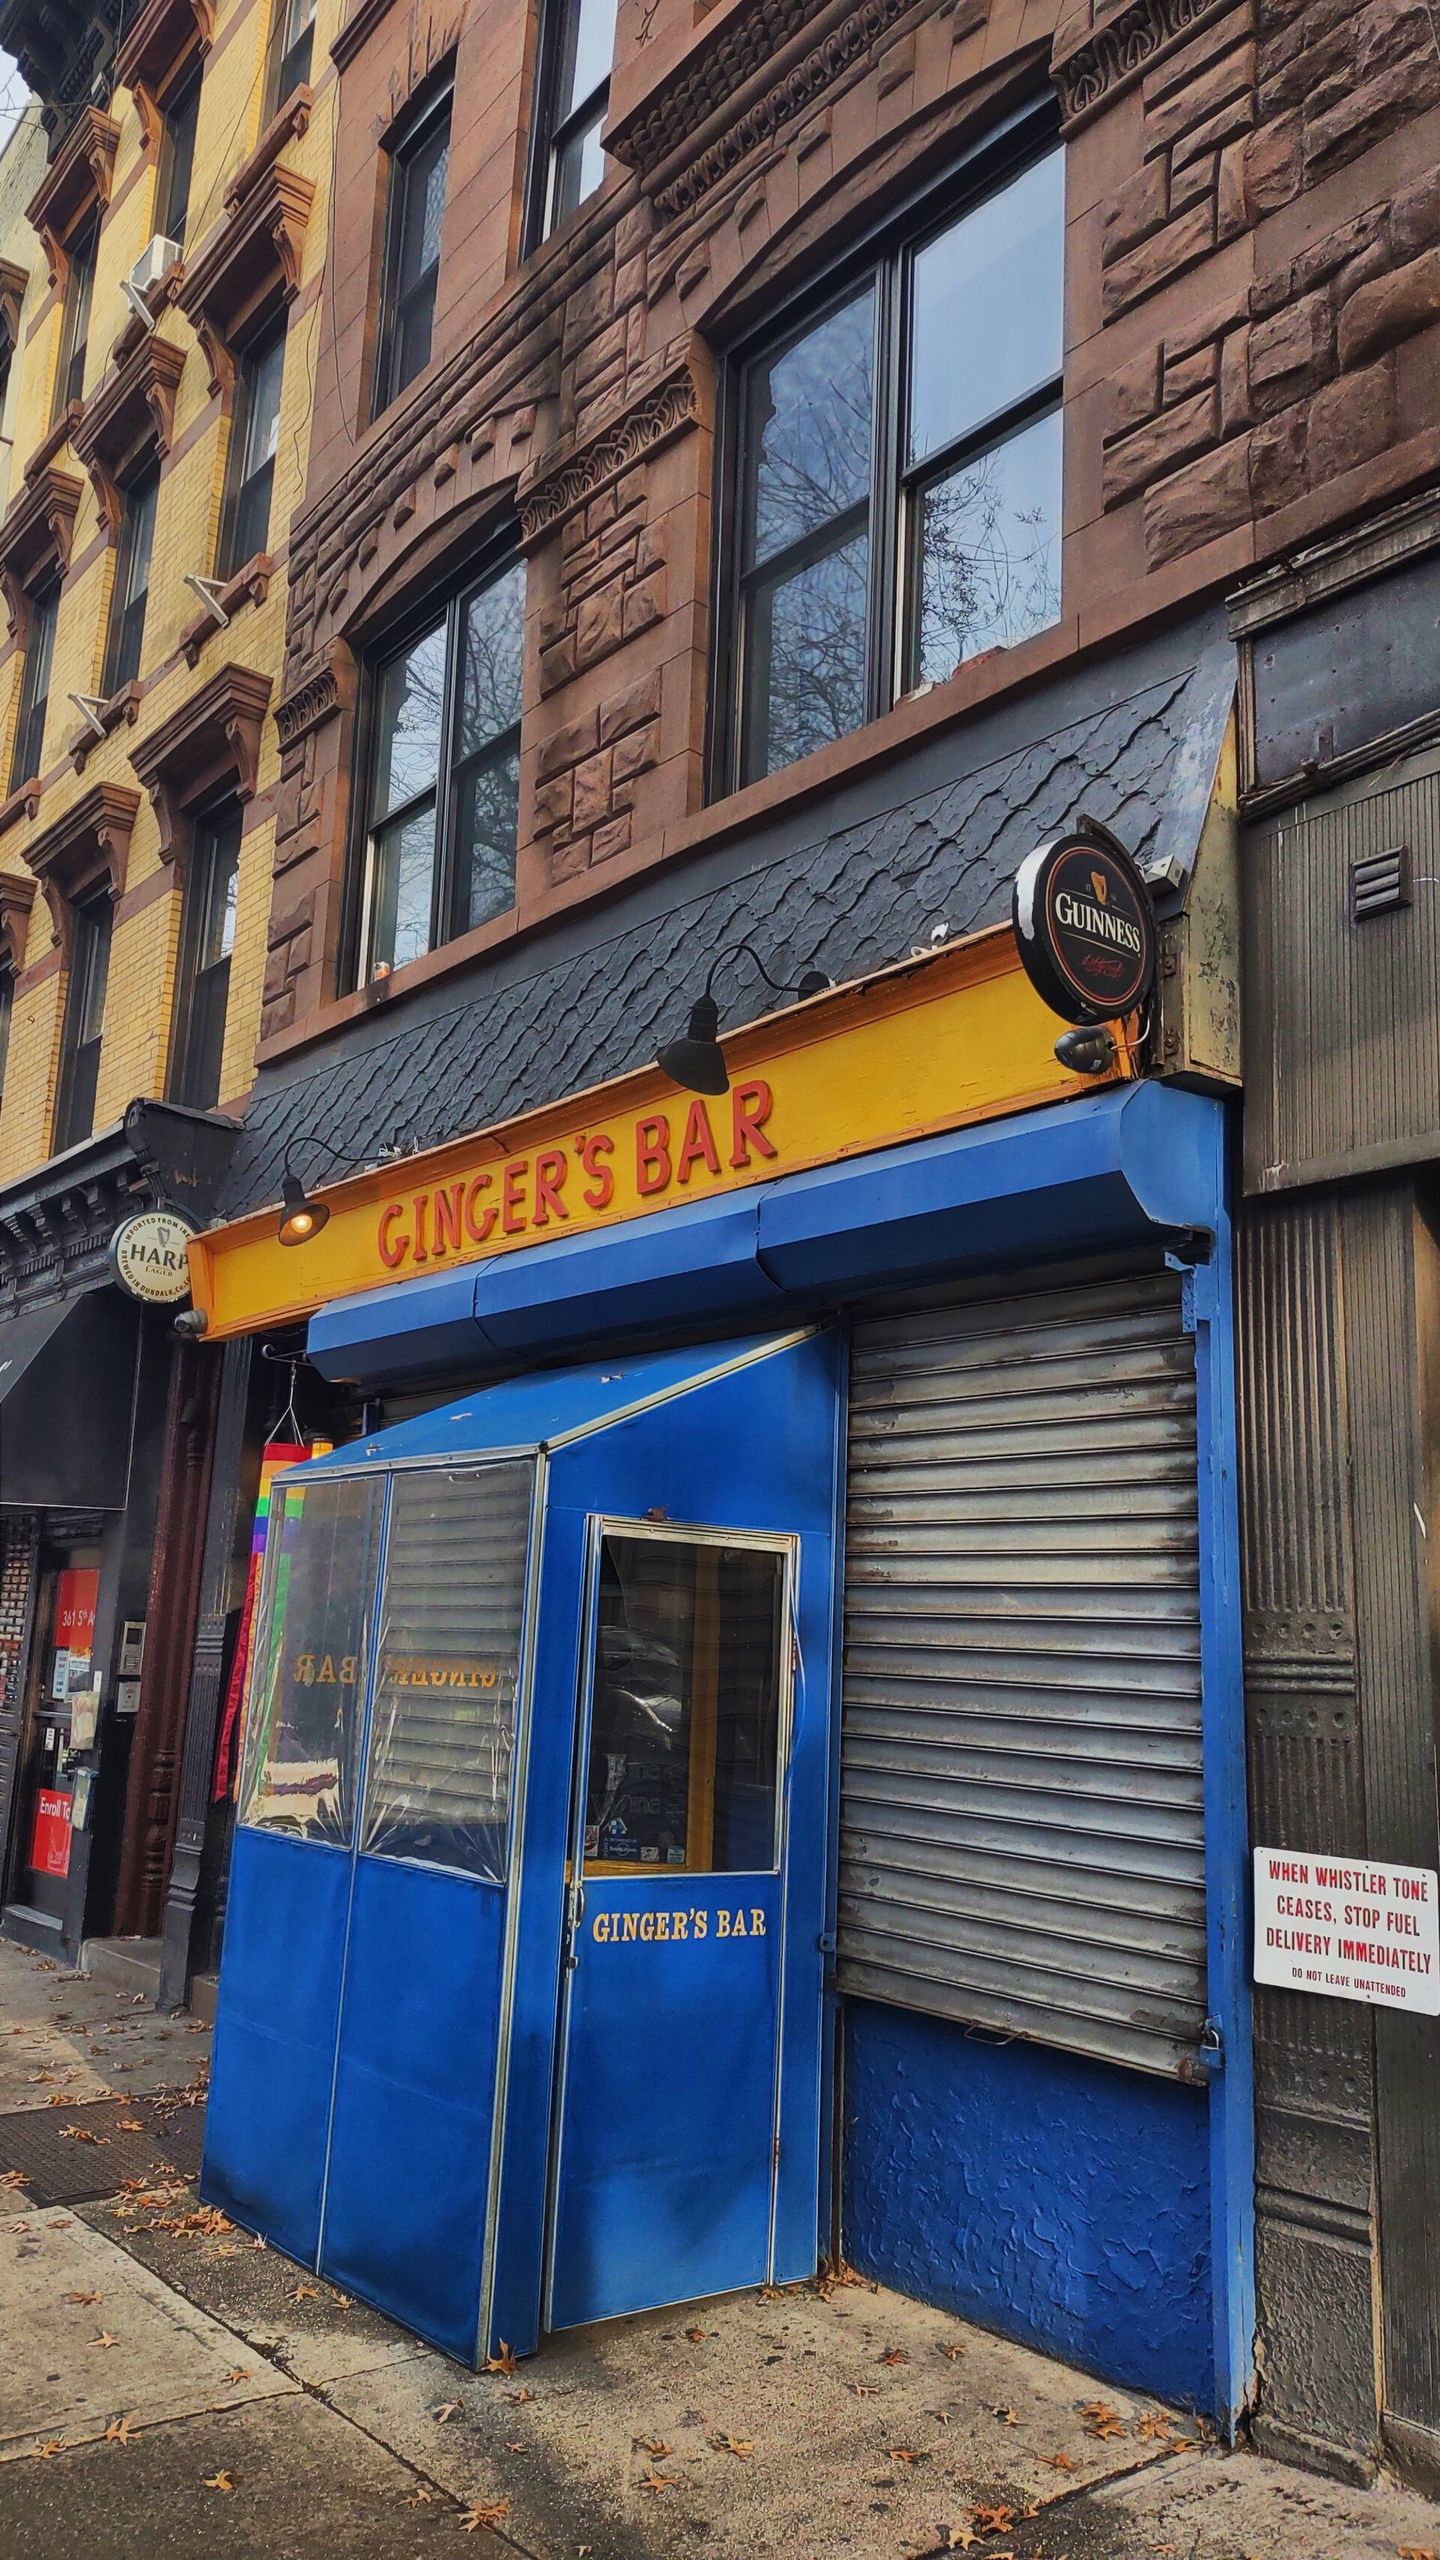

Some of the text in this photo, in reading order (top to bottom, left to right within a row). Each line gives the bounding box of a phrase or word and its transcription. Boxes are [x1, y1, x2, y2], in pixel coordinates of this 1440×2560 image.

[1055, 892, 1140, 953] GUINNESS
[378, 1080, 777, 1267] GINGER'S BAR
[124, 1217, 191, 1244] IMPORTED FROM IRE
[121, 1249, 134, 1280] BREWED
[132, 1279, 141, 1288] IN
[130, 1243, 189, 1271] HARP
[145, 1266, 173, 1277] LAGER
[62, 1610, 75, 1627] 361
[39, 1797, 61, 1816] Enroll
[1269, 1860, 1428, 1902] WHEN WHISTLER TONE
[592, 1908, 766, 1943] GINGER'S BAR
[1277, 1895, 1420, 1936] CEASES, STOP FUEL
[1266, 1927, 1431, 1974] DELIVERY IMMEDIATELY
[1292, 1967, 1406, 1998] DO NOT LEAVE UNATTENDED
